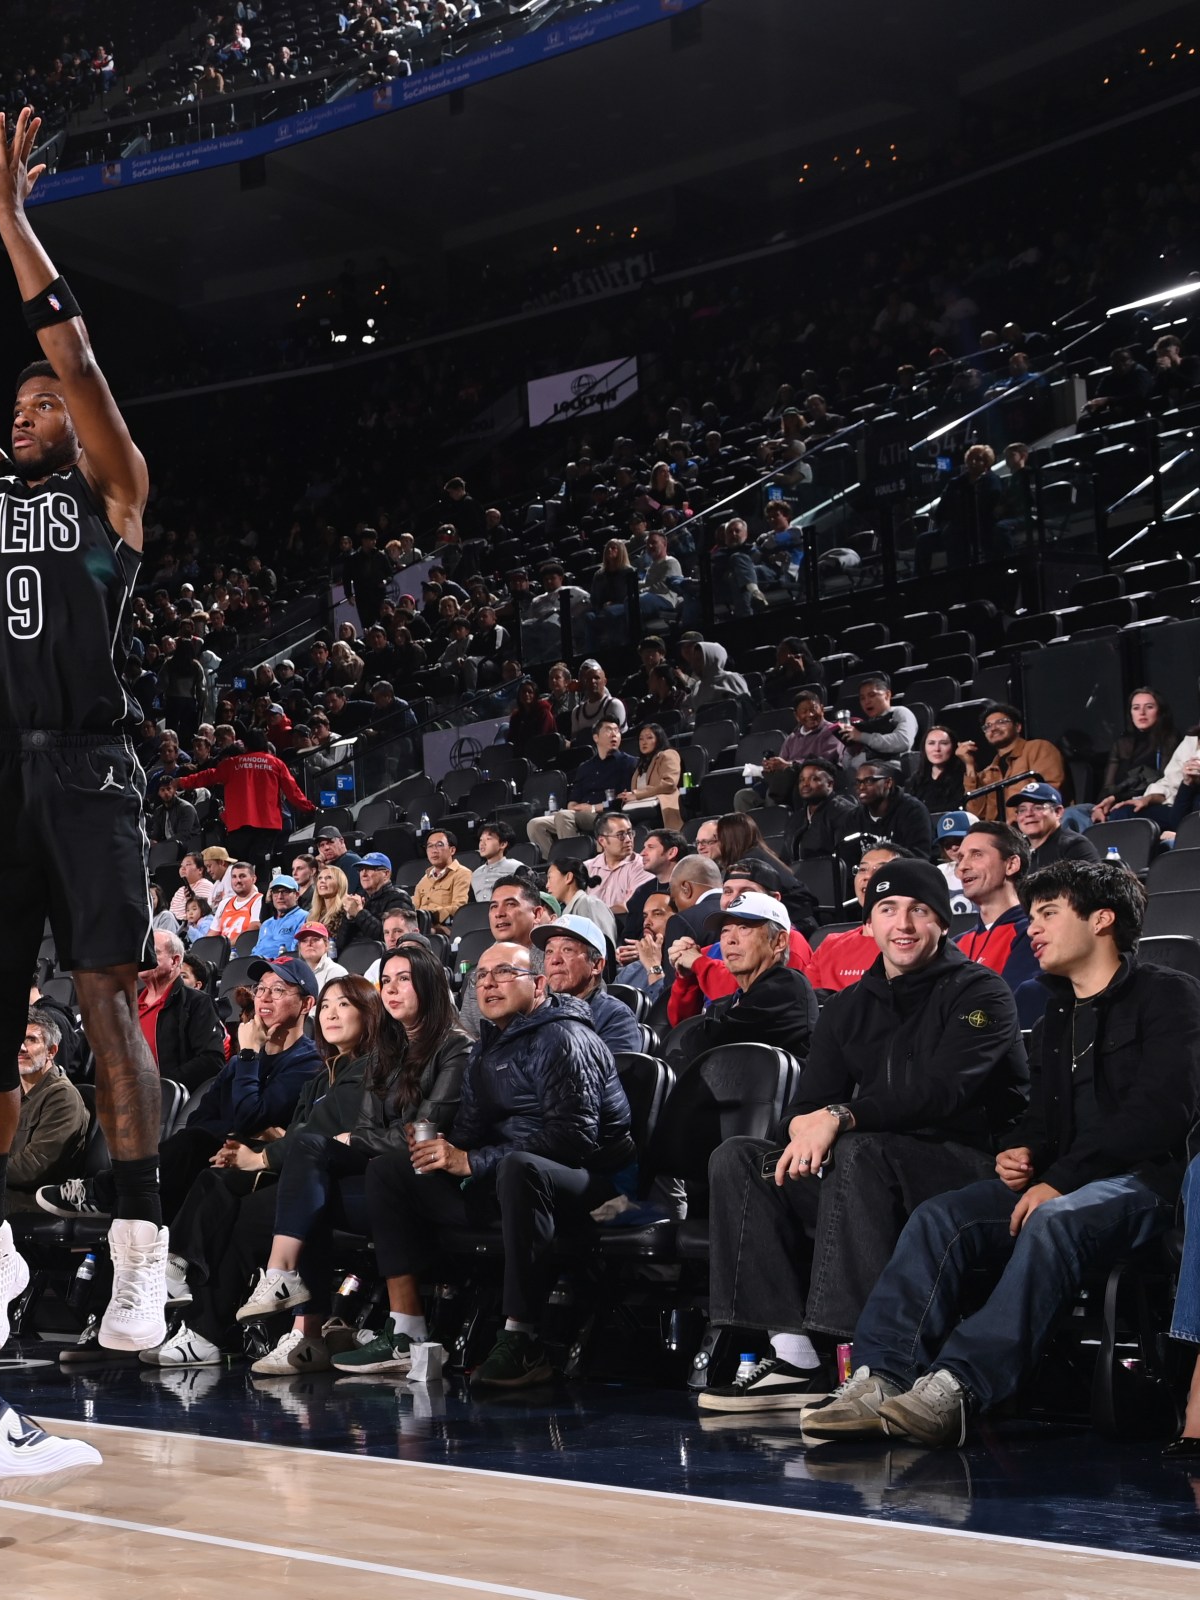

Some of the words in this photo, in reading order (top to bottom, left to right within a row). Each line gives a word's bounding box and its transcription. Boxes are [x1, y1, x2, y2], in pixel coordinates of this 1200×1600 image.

[490, 46, 514, 60] Honda
[403, 73, 470, 100] SoCalHonda.com
[132, 157, 151, 168] Score
[158, 152, 174, 163] deal
[191, 142, 218, 155] reliable
[219, 137, 243, 149] Honda
[132, 158, 199, 178] SoCalHonda.com
[6, 565, 43, 640] 9
[338, 780, 343, 788] 5
